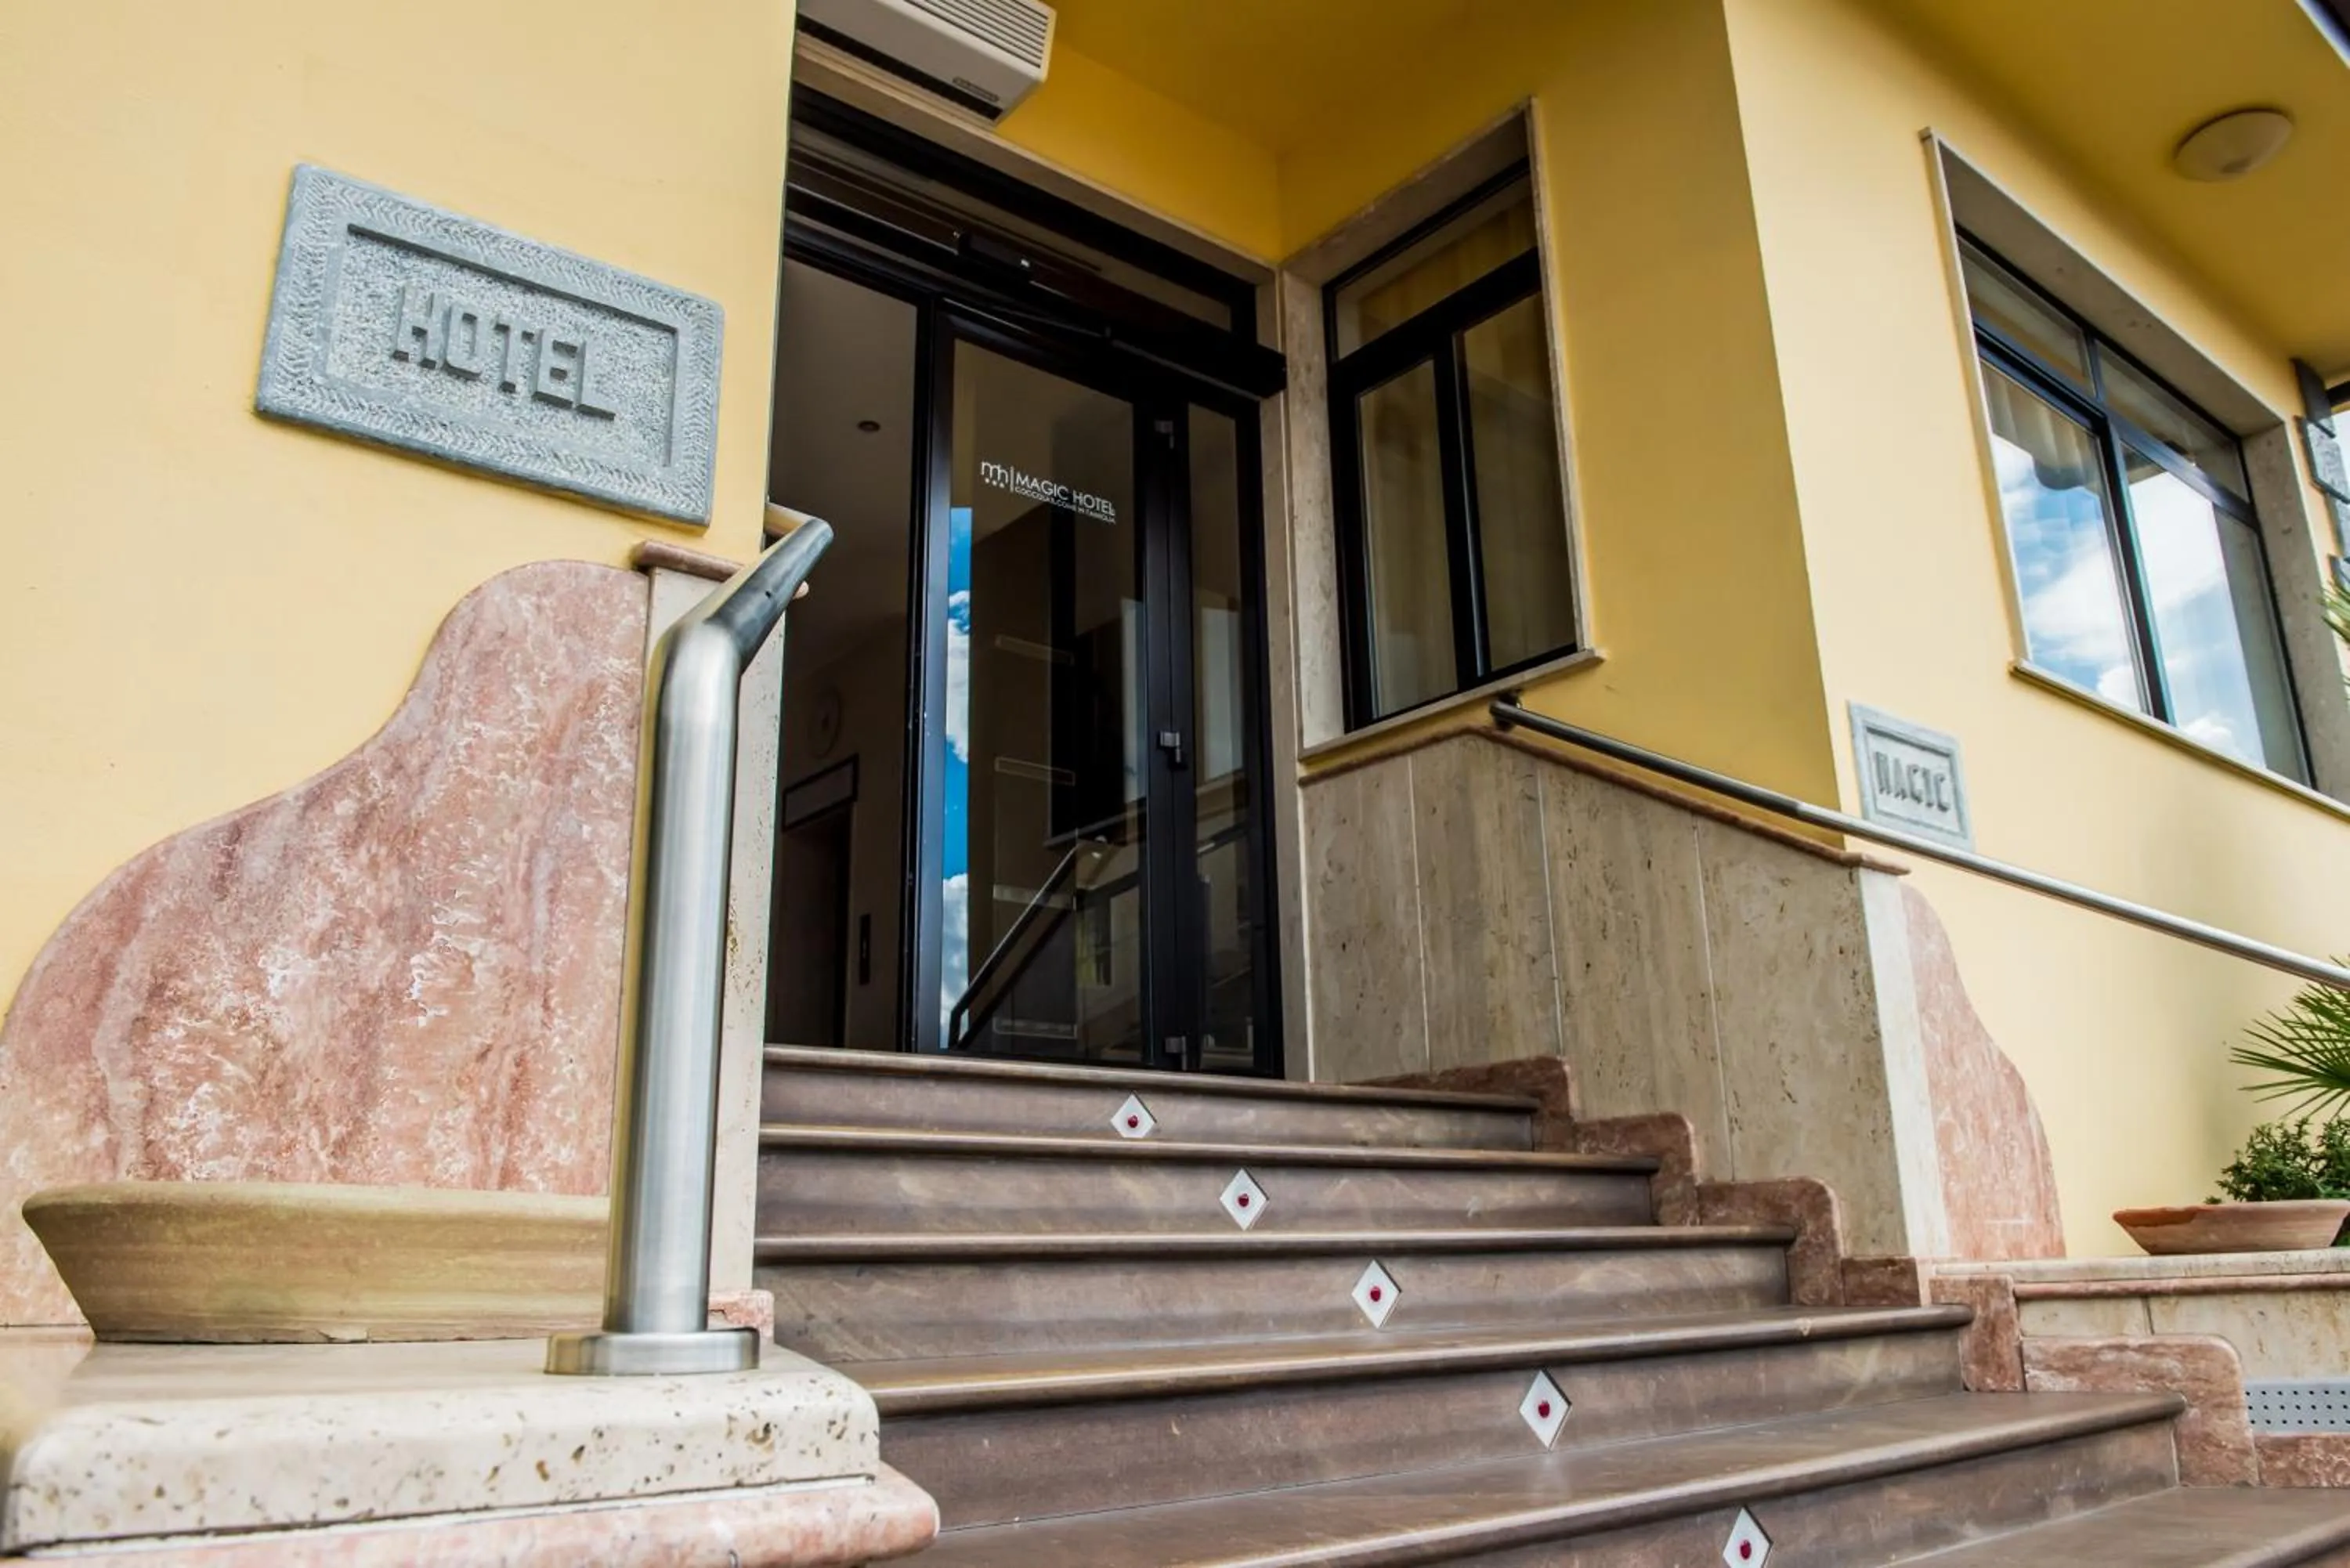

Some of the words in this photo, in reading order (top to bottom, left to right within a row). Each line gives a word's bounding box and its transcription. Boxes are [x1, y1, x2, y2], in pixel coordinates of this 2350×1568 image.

[392, 283, 616, 421] HOTEL
[1016, 471, 1068, 500] MAGIC
[1073, 490, 1115, 517] HOTEL
[1875, 751, 1950, 813] MAGIC
